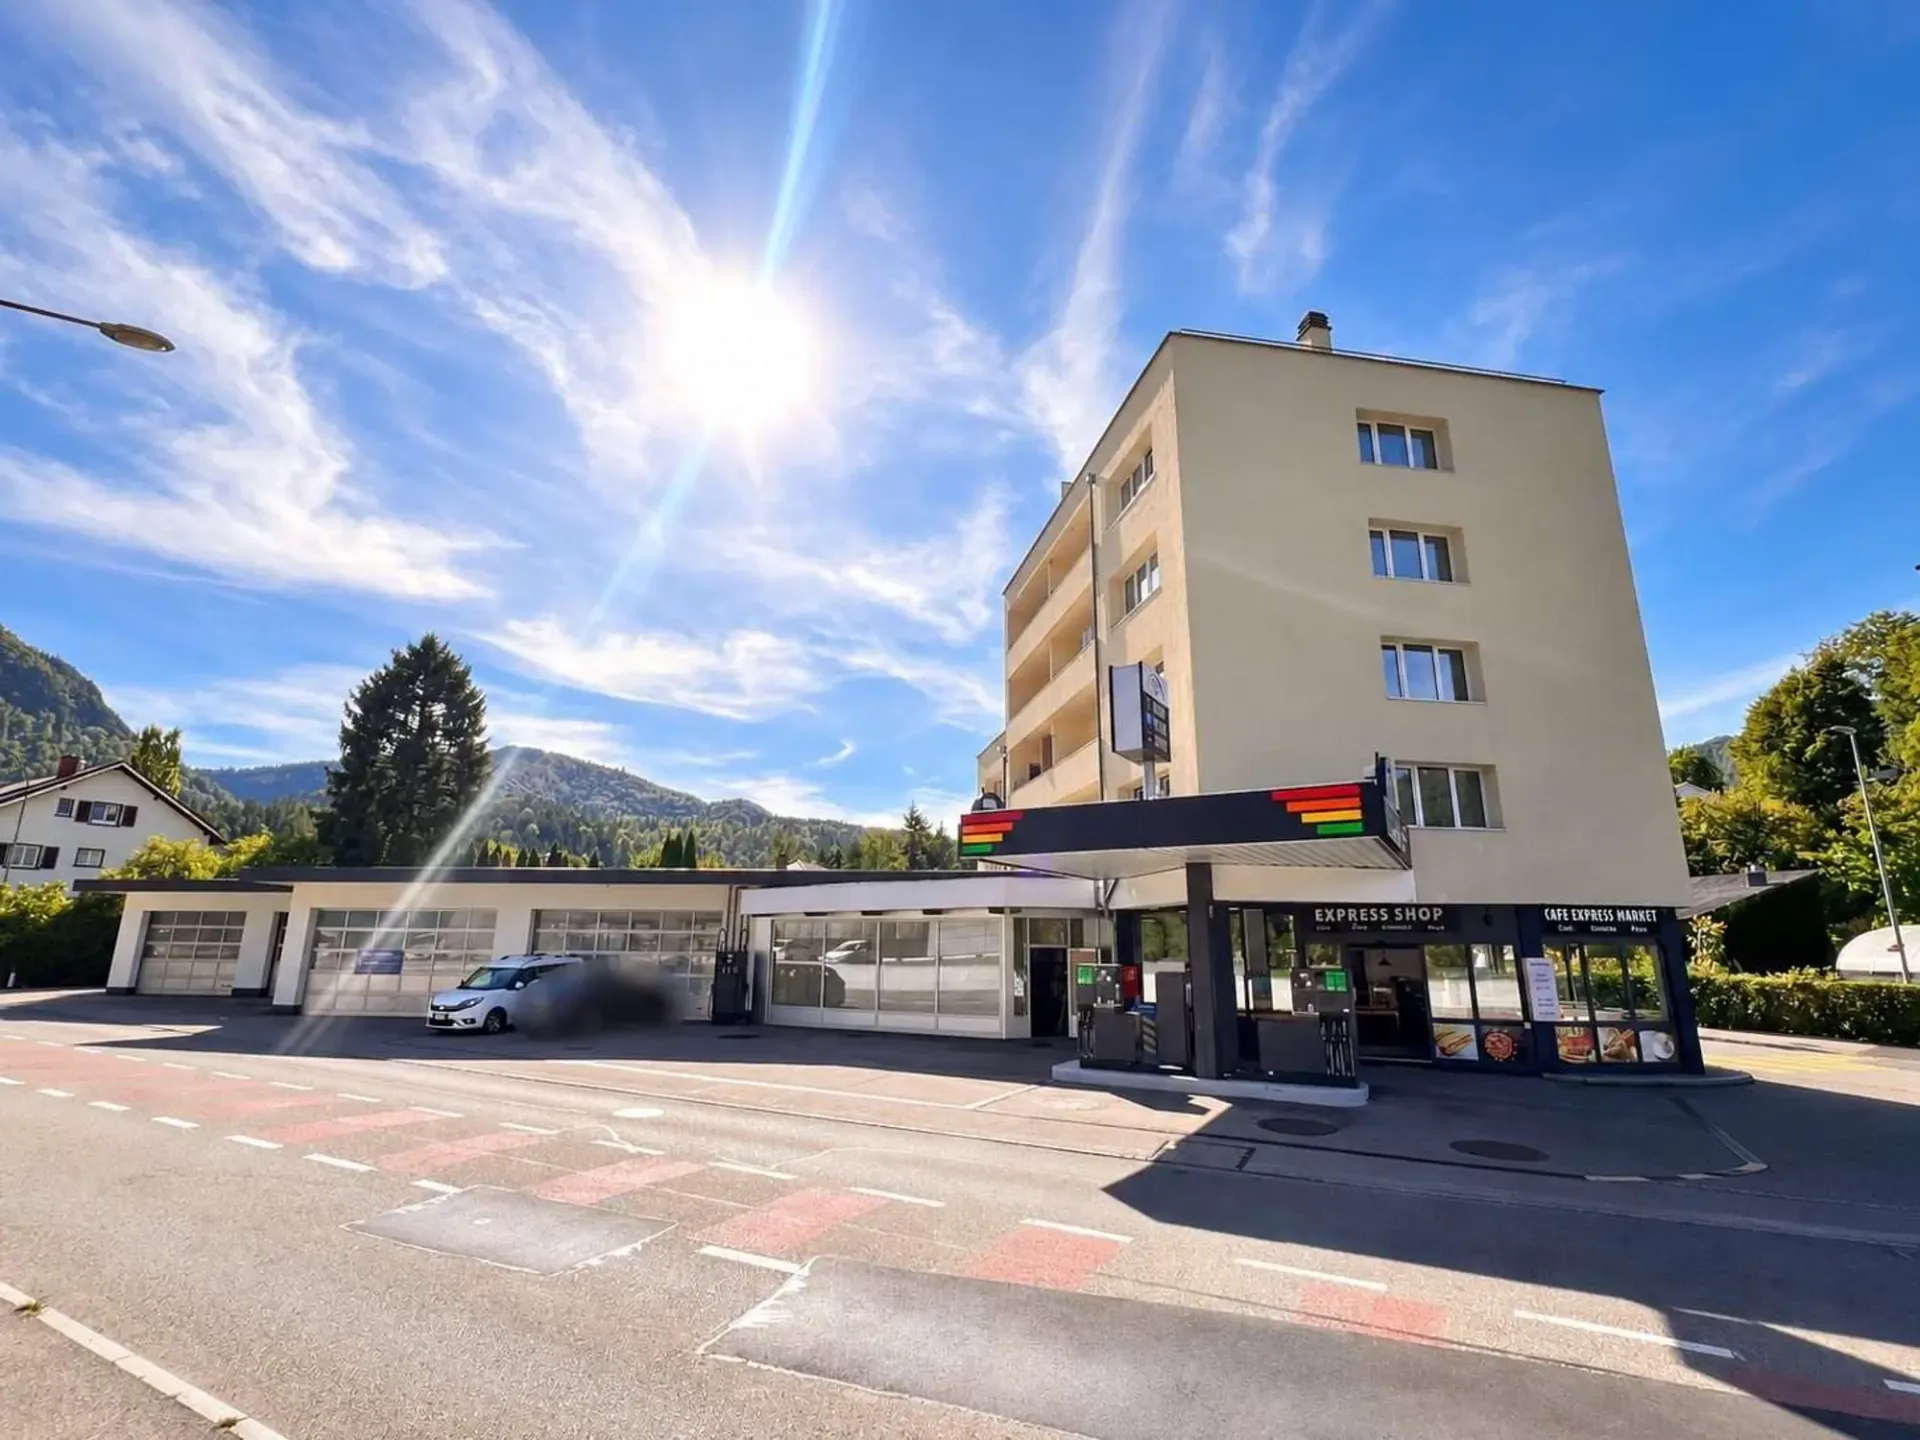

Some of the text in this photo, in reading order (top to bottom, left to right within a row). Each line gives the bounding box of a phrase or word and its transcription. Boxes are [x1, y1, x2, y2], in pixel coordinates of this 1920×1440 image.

[1314, 906, 1443, 922] EXPRESS SHOP
[1571, 908, 1614, 922] EXPRESS
[1617, 909, 1657, 923] MARKET
